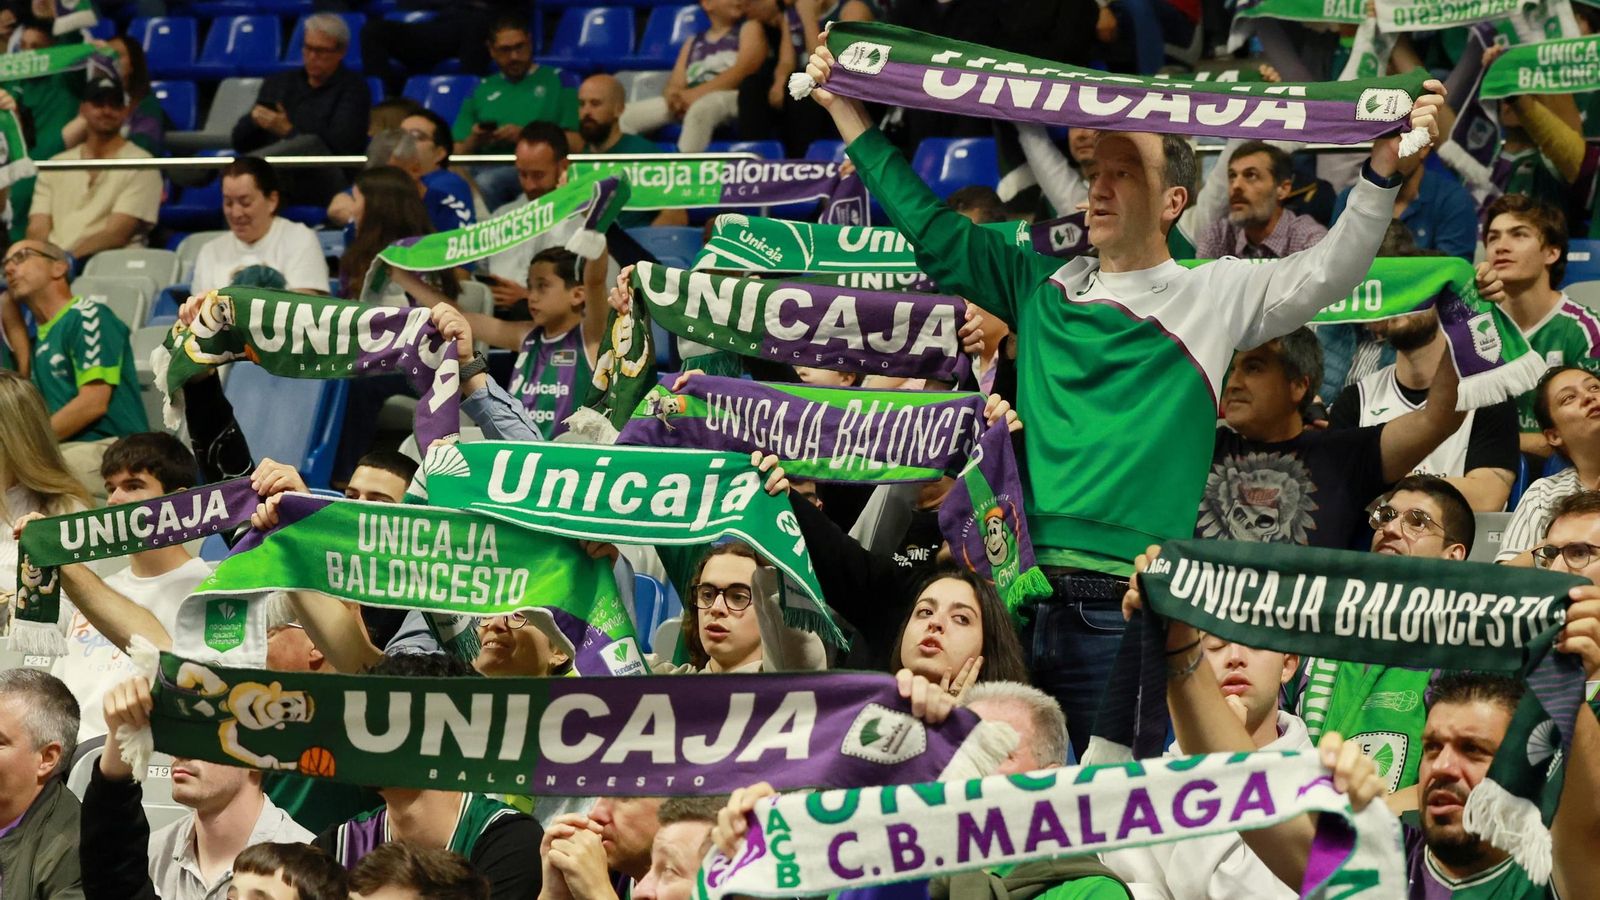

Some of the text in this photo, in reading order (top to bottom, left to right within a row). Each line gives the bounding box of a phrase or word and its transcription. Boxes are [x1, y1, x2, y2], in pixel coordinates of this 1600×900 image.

[445, 201, 555, 261] BALONCESTO
[738, 229, 785, 263] Unicaja
[636, 260, 959, 359] UNICAJA
[686, 324, 891, 370] BALONCESTO
[705, 392, 830, 463] UNICAJA
[59, 489, 230, 550] UNICAJA
[487, 450, 761, 532] Unicaja
[73, 524, 219, 559] BALONCESTO
[357, 512, 499, 563] UNICAJA
[325, 550, 530, 606] BALONCESTO
[1168, 557, 1328, 634] UNICAJA
[613, 660, 642, 676] Fundación
[343, 690, 819, 764] UNICAJA
[428, 768, 705, 788] BALONCESTO
[956, 771, 1277, 864] MALAGA
